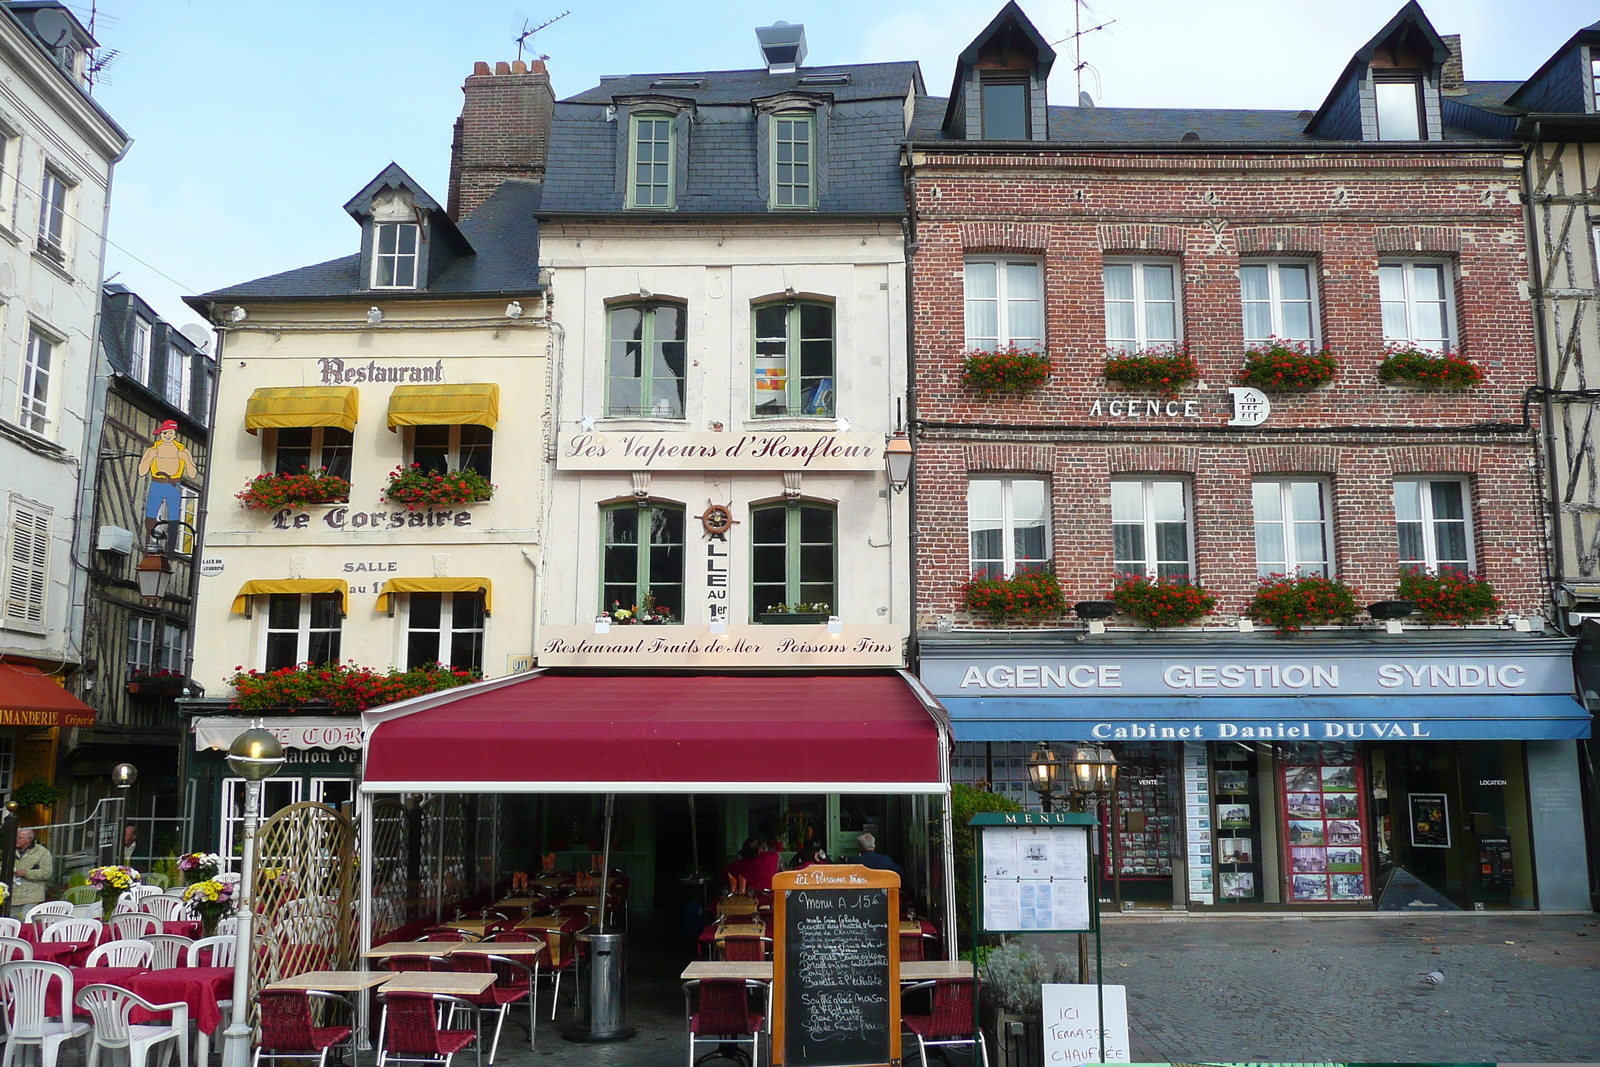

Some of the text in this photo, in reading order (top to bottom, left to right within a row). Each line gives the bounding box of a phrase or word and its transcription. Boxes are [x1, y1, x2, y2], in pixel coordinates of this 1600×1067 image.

[317, 358, 443, 385] Restaurant
[1088, 399, 1199, 418] AGENCE
[564, 434, 878, 467] Les Vapeurs d'Honfleur
[271, 507, 472, 531] Le Corsaire
[343, 562, 398, 573] SALLE
[349, 584, 367, 594] au
[707, 590, 726, 599] AU
[543, 637, 896, 655] Restaurant Fruits de Mer Poissons Fins
[959, 664, 1527, 689] AGENCE GESTION SYNDIC
[1092, 722, 1431, 739] Cabinet Daniel DUVAL
[338, 747, 358, 763] de
[1005, 814, 1066, 823] MENU
[795, 873, 809, 885] ici
[798, 891, 834, 910] Menu
[838, 897, 847, 909] A
[1059, 1007, 1079, 1020] ICI
[1051, 1045, 1123, 1062] CHAUFÉE
